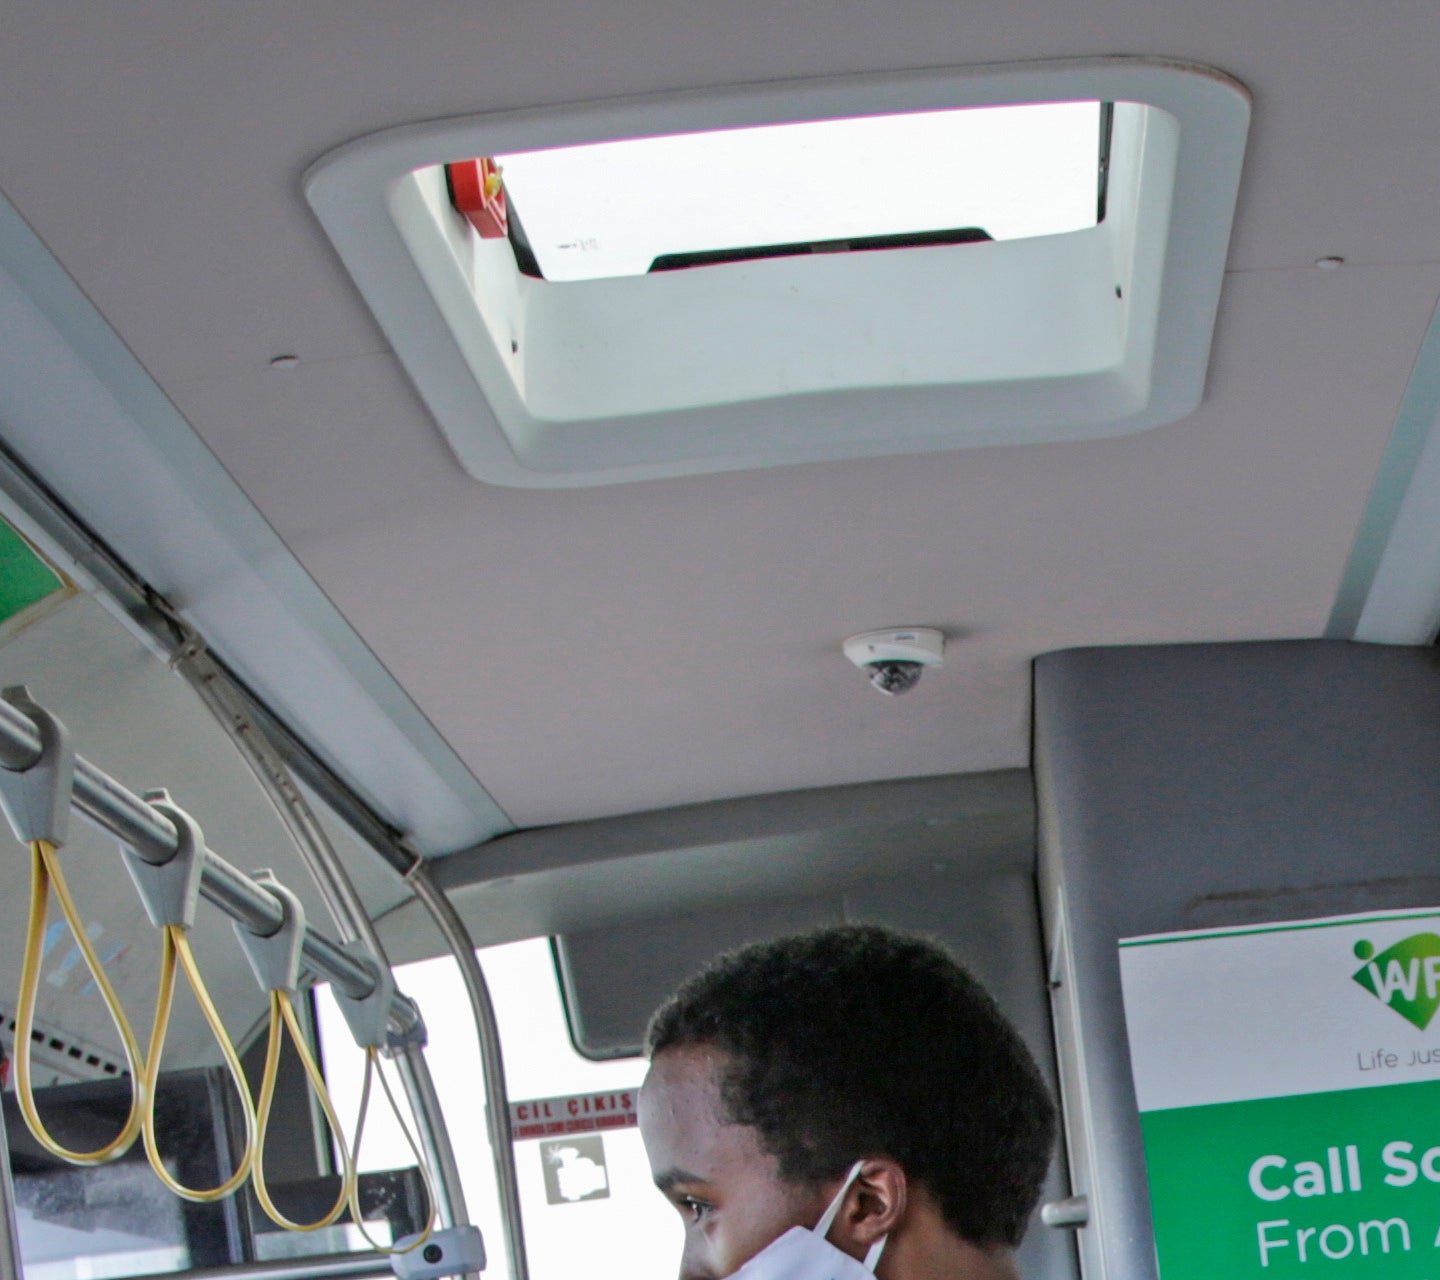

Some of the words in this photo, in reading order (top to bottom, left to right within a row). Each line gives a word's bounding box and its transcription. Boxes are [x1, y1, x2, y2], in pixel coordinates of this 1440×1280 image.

[1357, 1049, 1399, 1072] Life
[1248, 1144, 1362, 1202] Call
[1256, 1216, 1412, 1268] From
